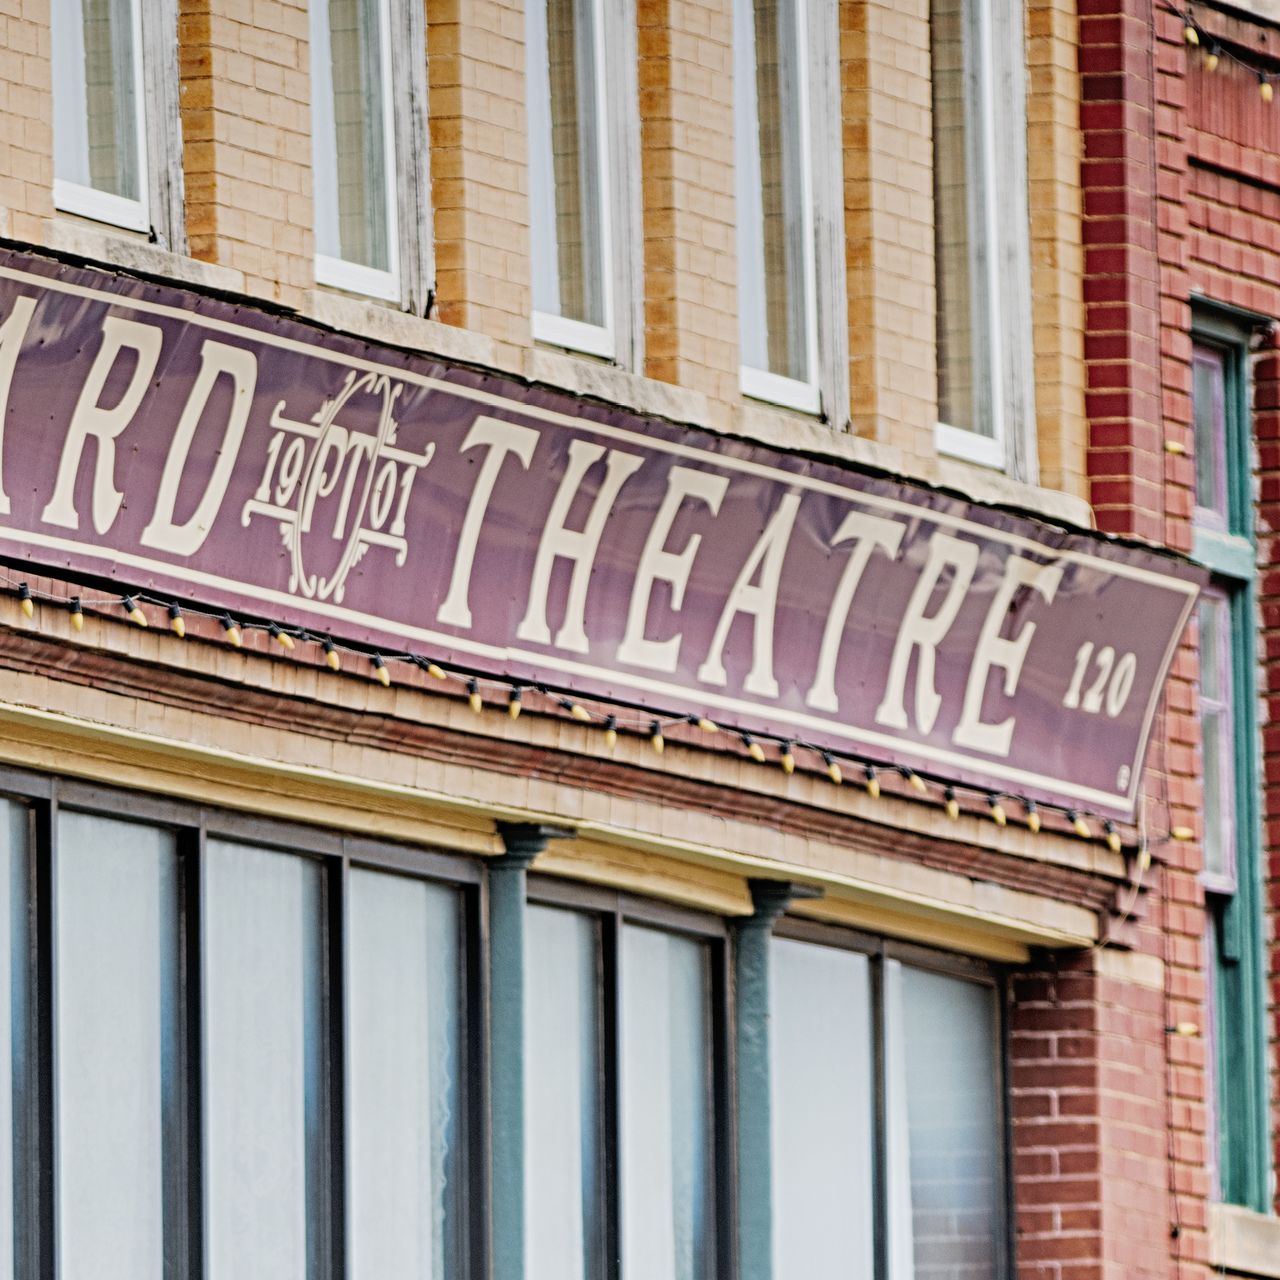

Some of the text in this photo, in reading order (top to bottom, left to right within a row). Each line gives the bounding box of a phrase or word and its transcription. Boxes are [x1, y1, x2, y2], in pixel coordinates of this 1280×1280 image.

[253, 431, 307, 507] 19
[435, 413, 1068, 758] THEATRE
[1061, 640, 1138, 719] 120
